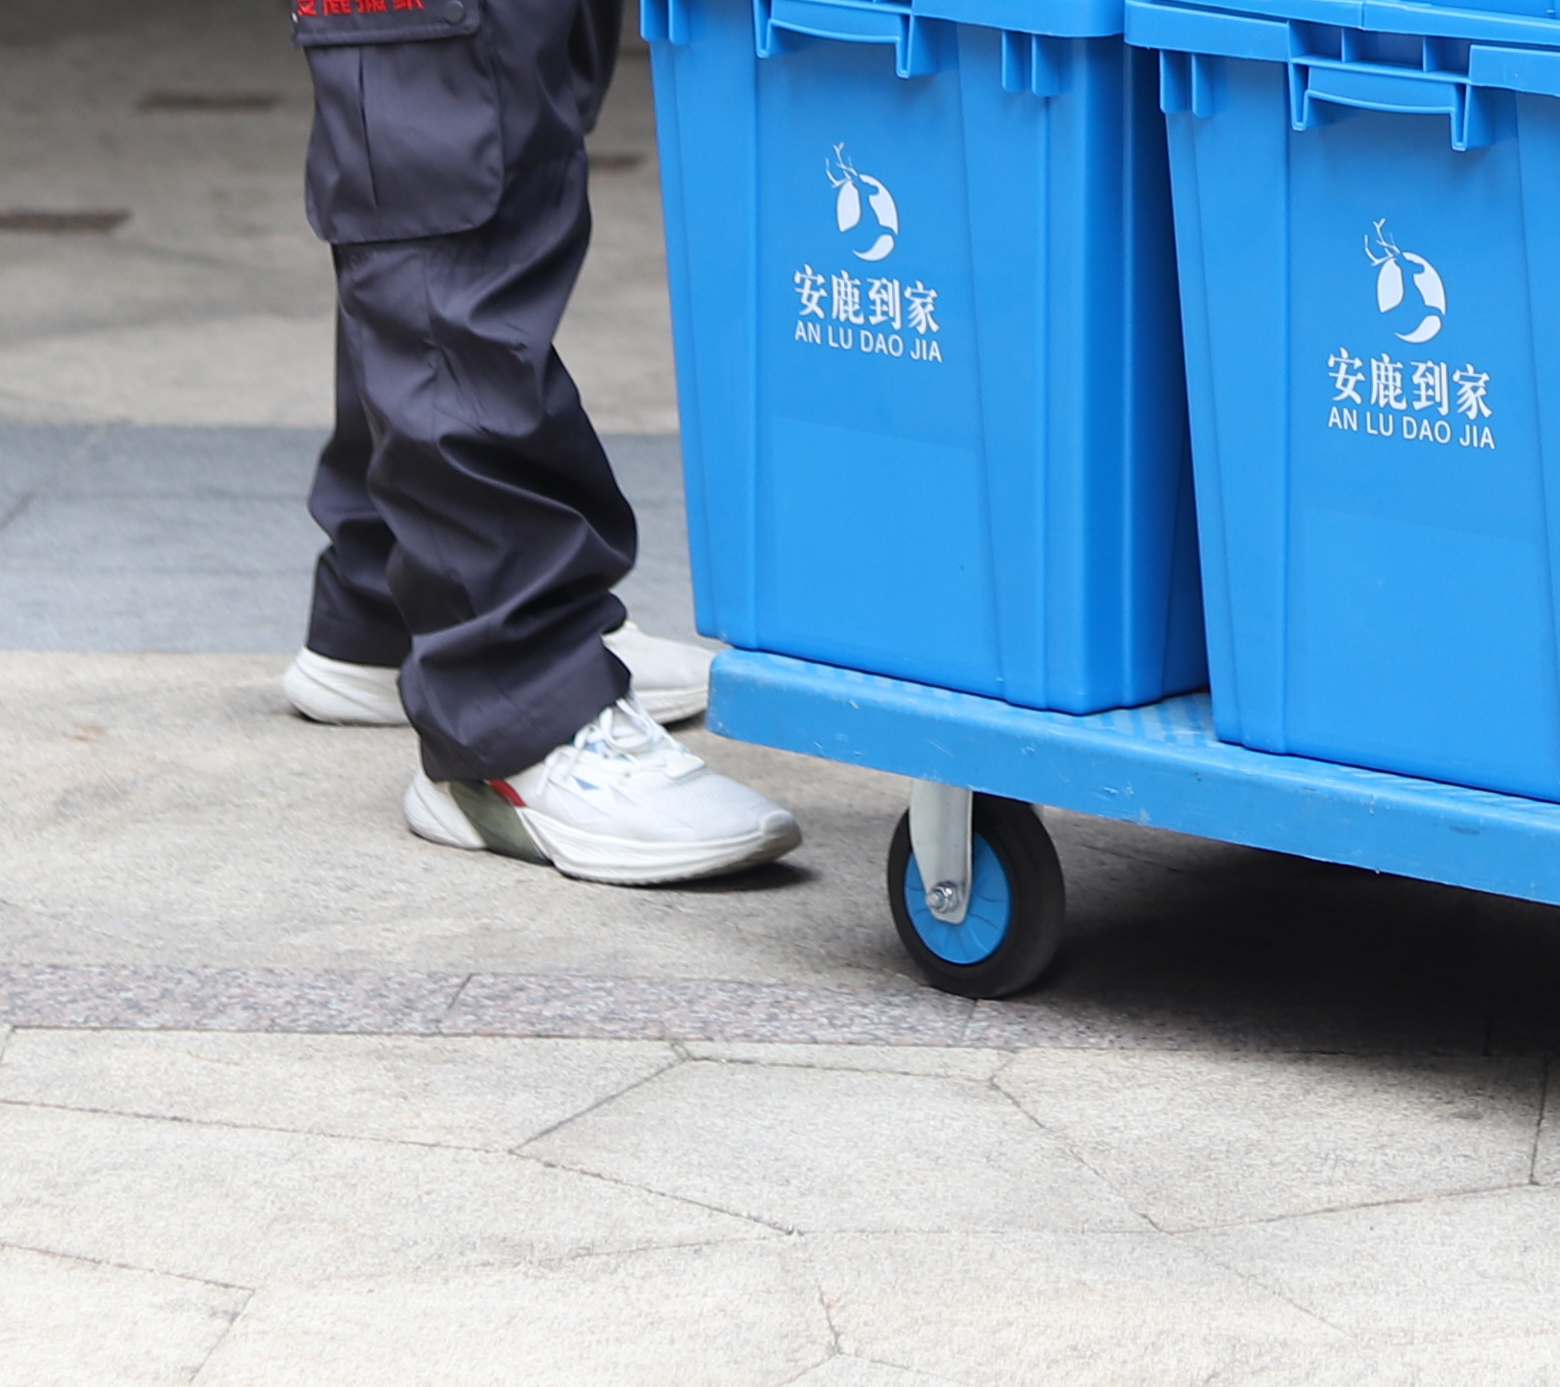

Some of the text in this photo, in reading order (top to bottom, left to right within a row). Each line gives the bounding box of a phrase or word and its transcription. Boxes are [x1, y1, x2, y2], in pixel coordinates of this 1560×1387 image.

[793, 263, 941, 335] 安鹿到家
[795, 320, 942, 363] AN LU DAO JIA
[1327, 346, 1493, 421] 安鹿到家
[1328, 406, 1495, 450] AN LU DAO JIA
